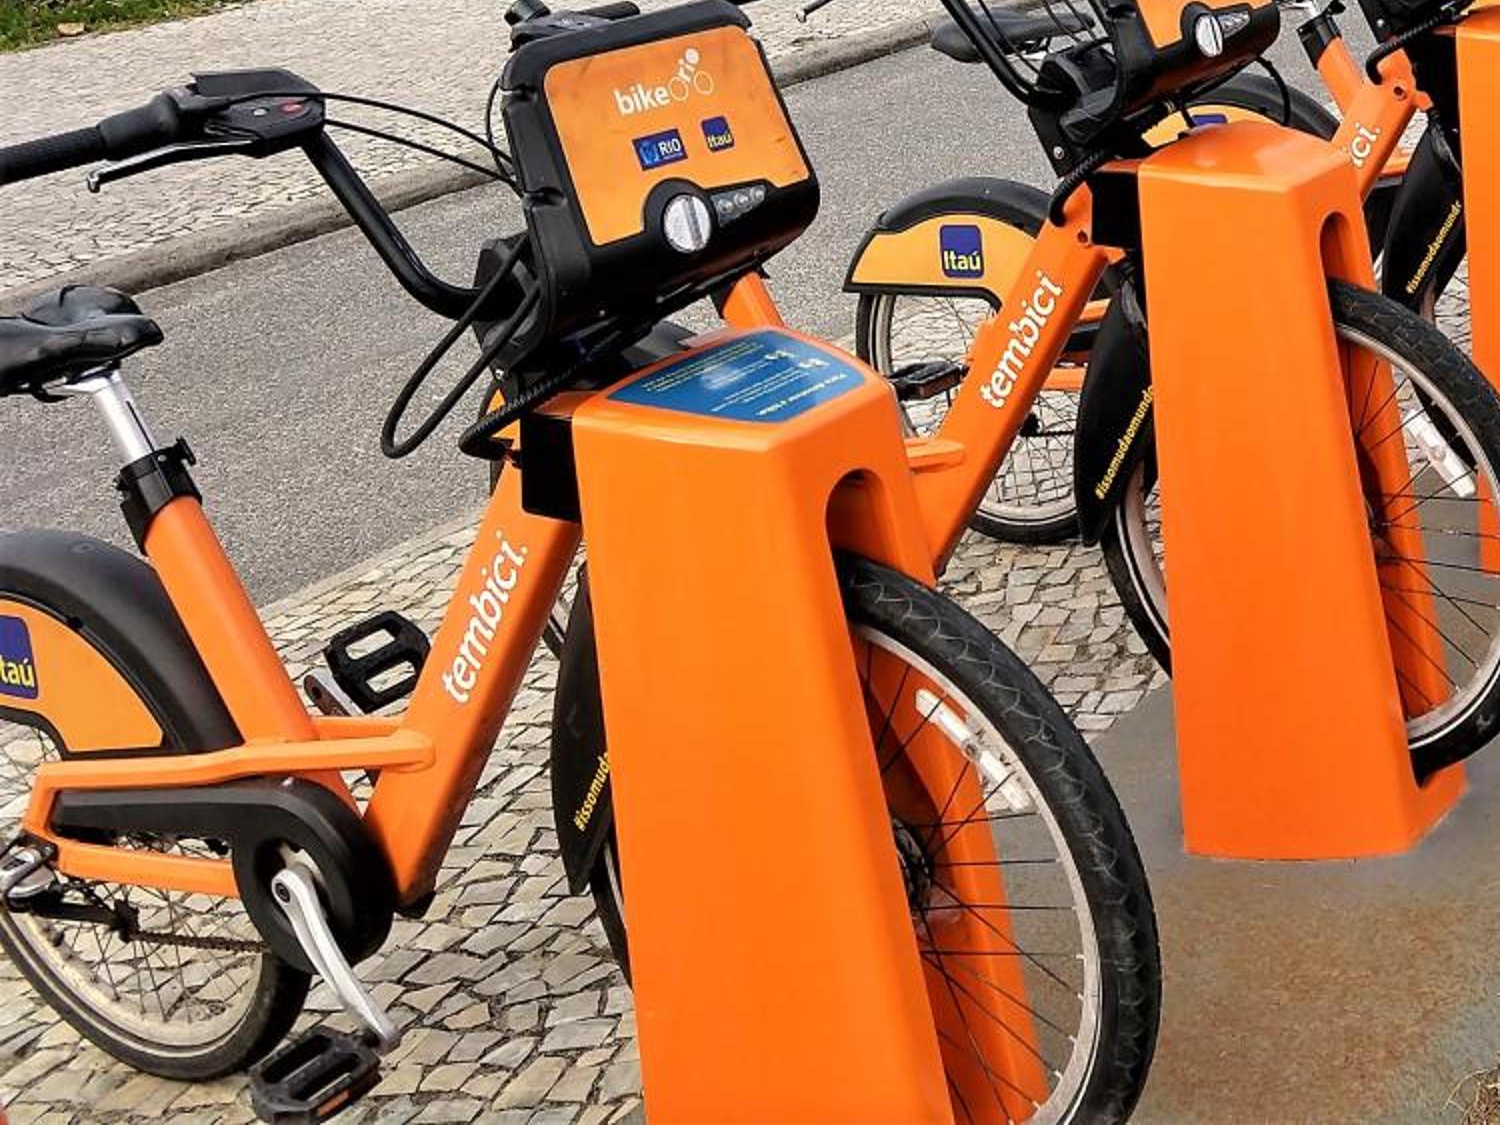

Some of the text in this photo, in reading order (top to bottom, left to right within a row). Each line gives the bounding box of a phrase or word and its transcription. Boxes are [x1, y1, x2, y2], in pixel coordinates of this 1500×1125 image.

[613, 83, 670, 115] bike
[658, 138, 681, 155] RIO
[943, 251, 981, 271] Itaú
[980, 271, 1063, 408] tembici
[0, 655, 36, 688] taú
